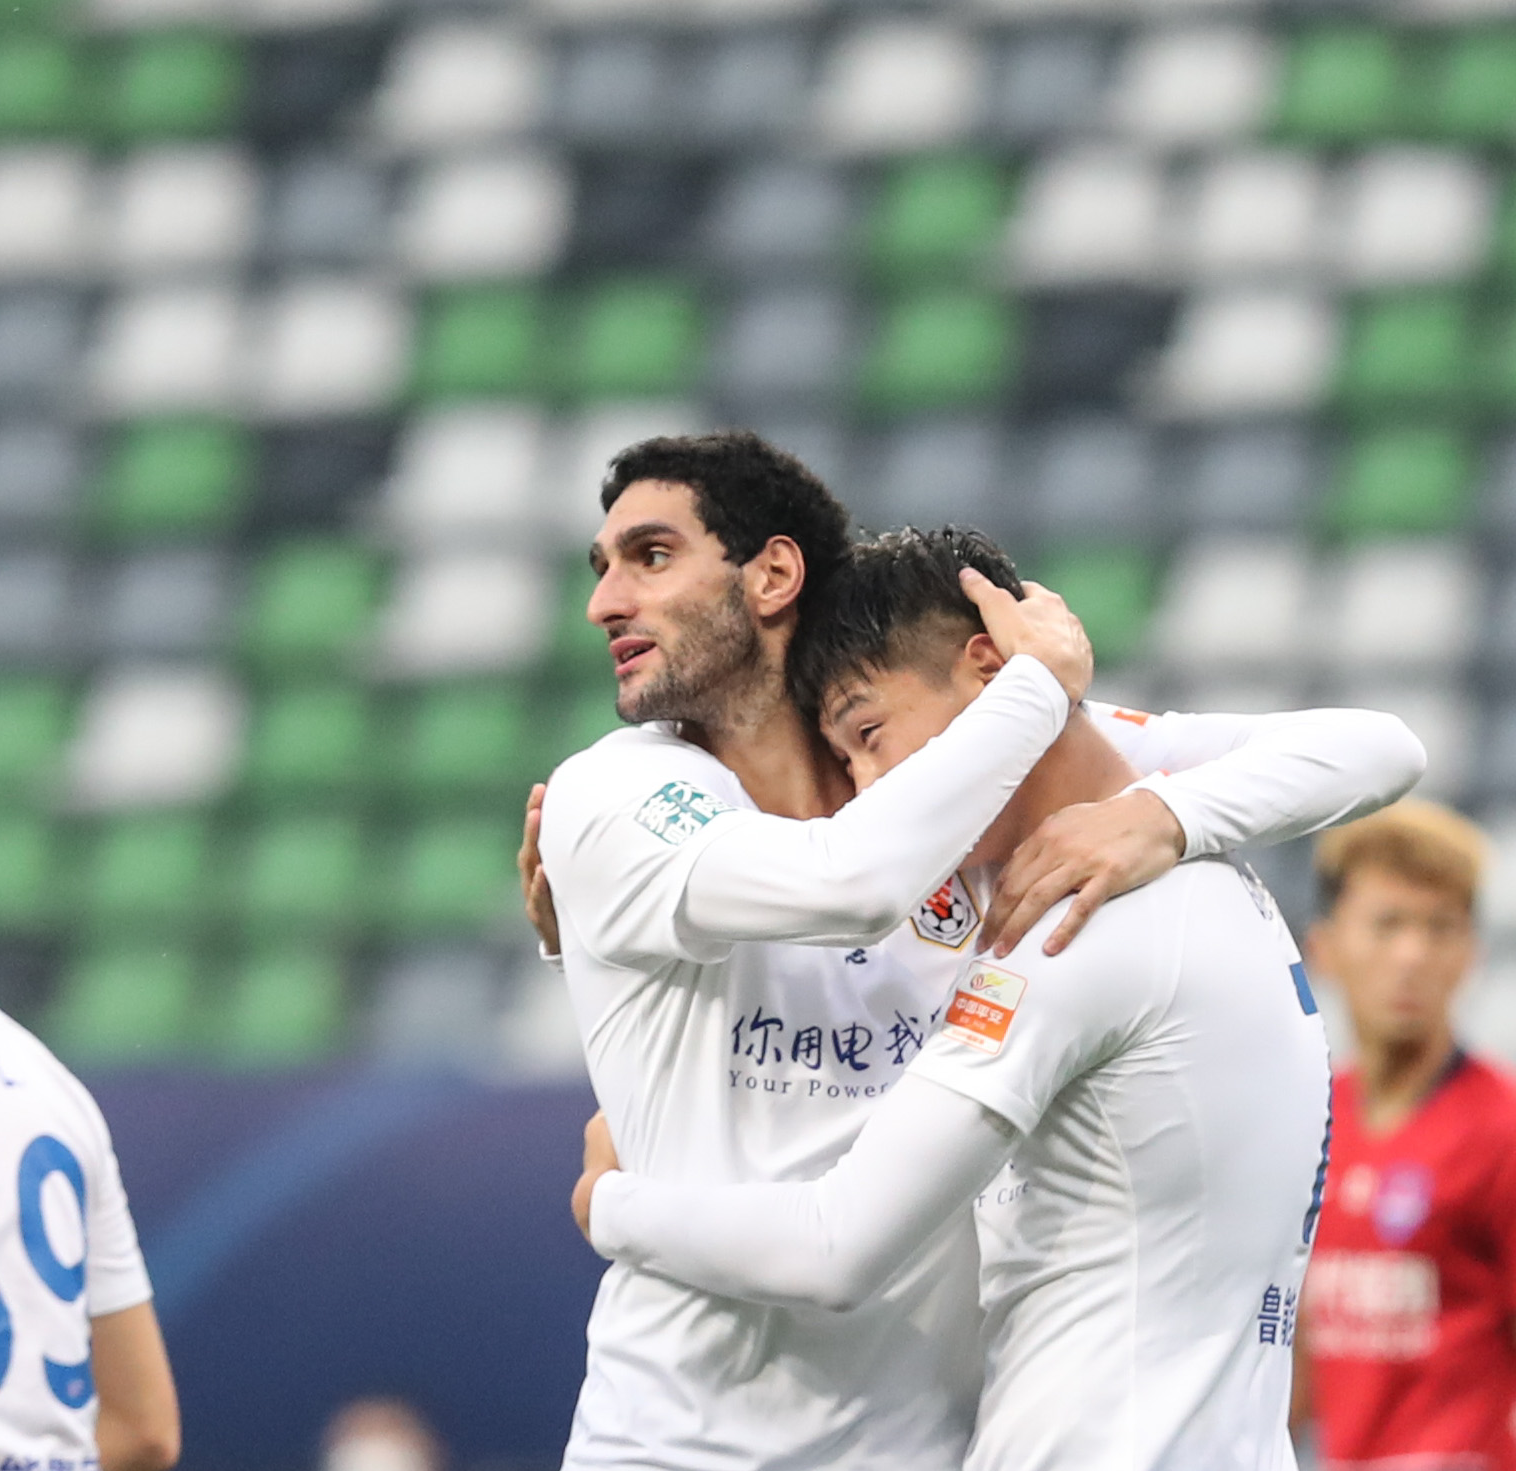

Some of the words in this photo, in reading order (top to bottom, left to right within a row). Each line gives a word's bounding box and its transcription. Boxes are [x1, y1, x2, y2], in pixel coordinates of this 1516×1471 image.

[732, 1006, 942, 1071] 你用电我
[729, 1070, 792, 1094] Your
[809, 1079, 889, 1099] Power
